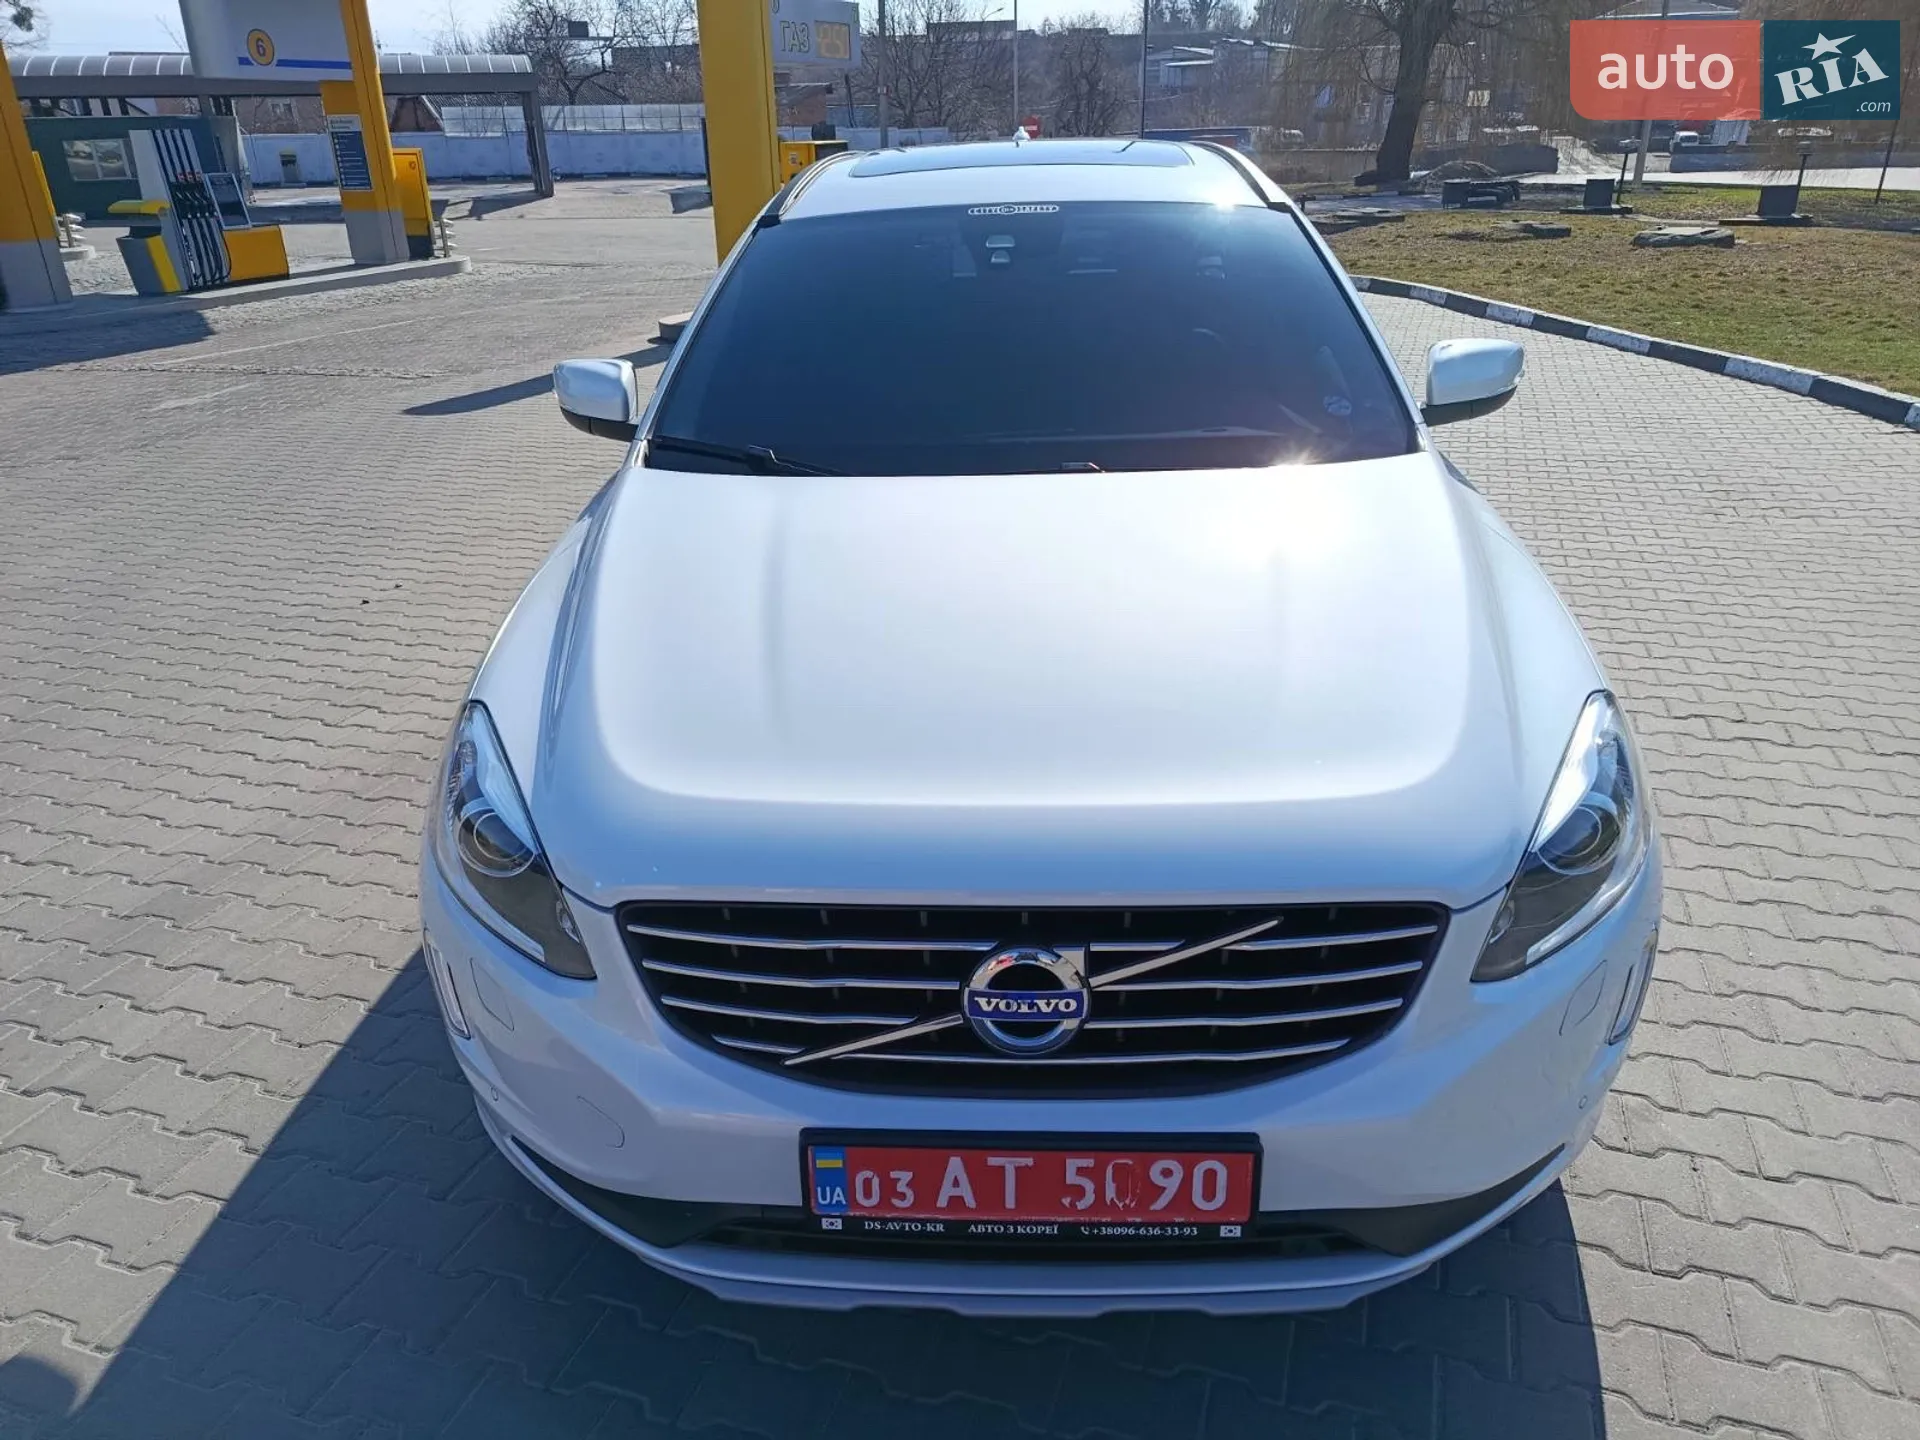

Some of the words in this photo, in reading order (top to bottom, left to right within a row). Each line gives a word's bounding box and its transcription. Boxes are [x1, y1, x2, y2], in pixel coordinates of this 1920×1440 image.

[779, 20, 809, 53] ГАЗ
[255, 37, 267, 58] 6
[974, 997, 1078, 1013] VOLVO
[855, 1170, 915, 1208] 03
[936, 1156, 1034, 1210] AT
[816, 1186, 847, 1205] UA
[864, 1220, 945, 1232] DS-AVTO-KR
[968, 1223, 1004, 1234] АВТО
[1091, 1225, 1198, 1236] +38096-636-33-93
